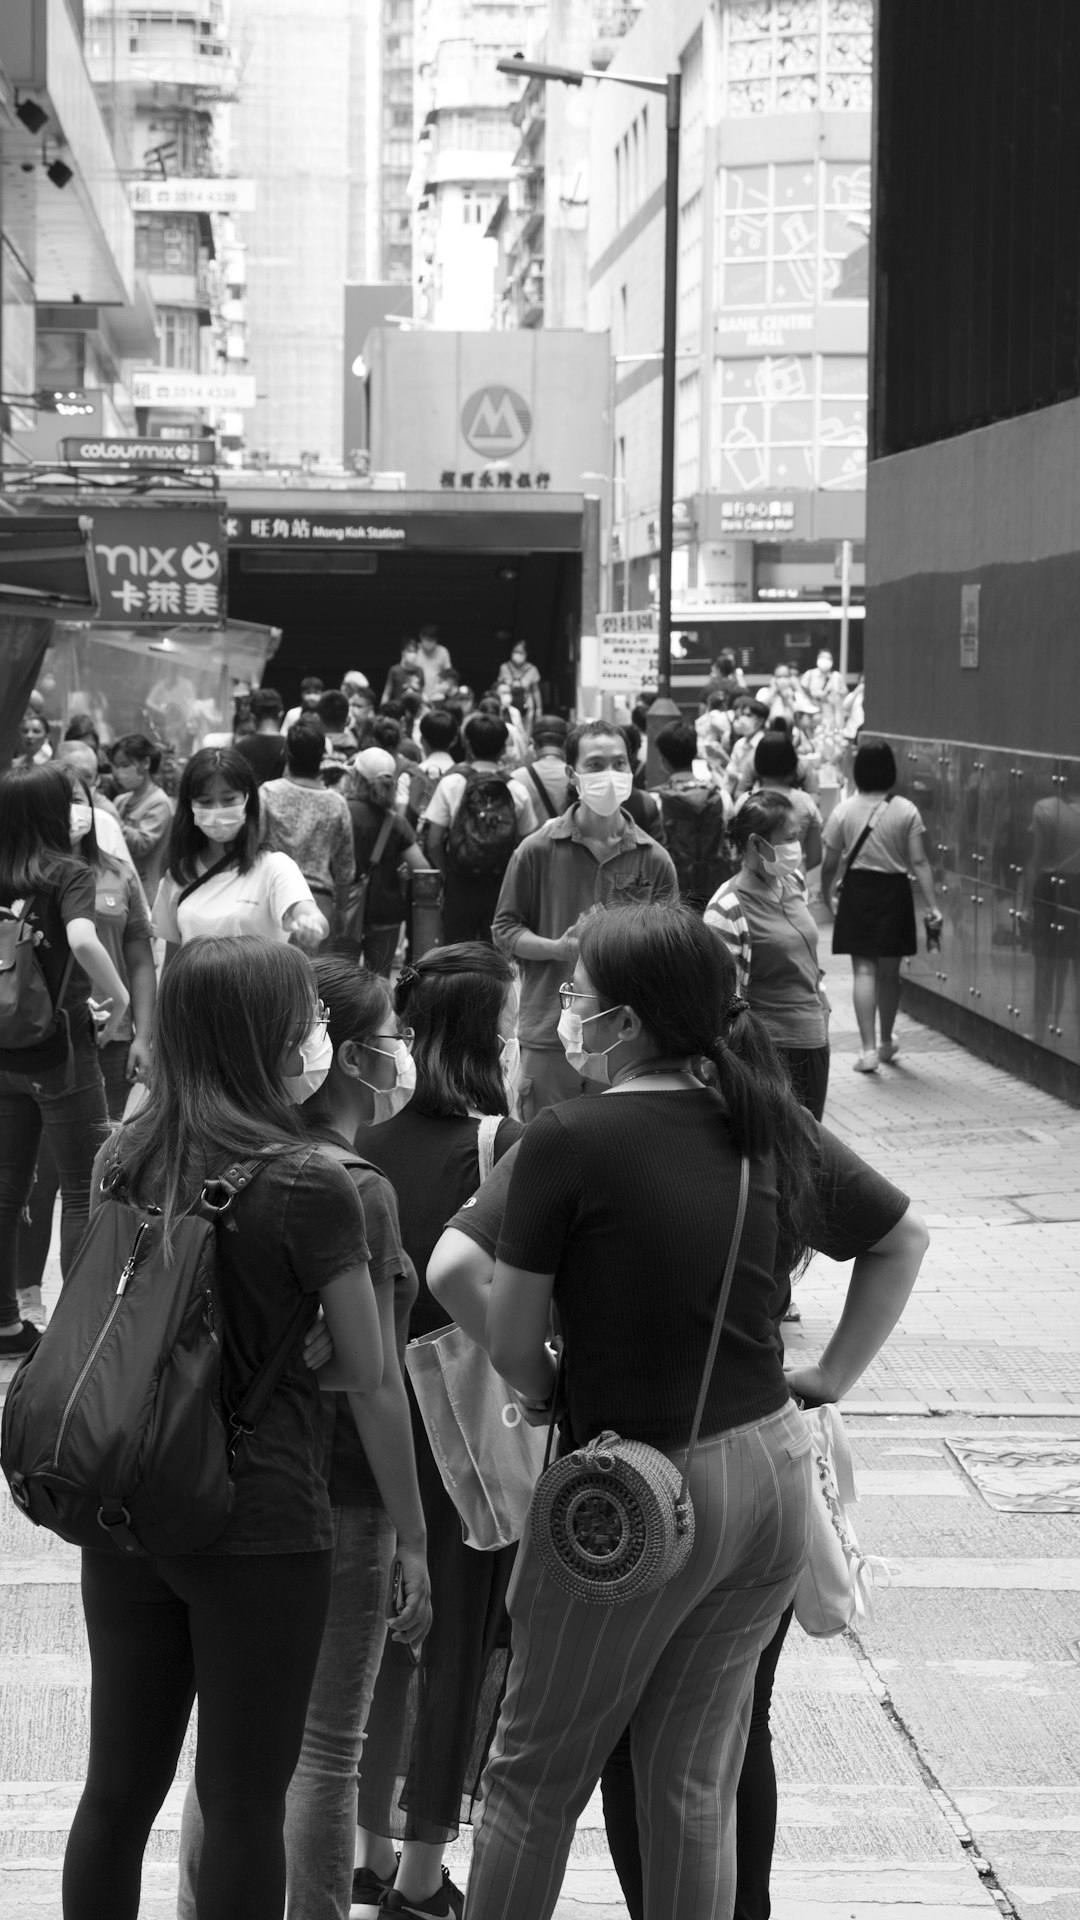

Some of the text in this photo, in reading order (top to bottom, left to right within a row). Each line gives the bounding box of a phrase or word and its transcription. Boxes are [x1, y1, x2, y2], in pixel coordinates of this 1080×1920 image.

[718, 312, 814, 334] BANK CENTRE
[746, 330, 785, 347] MALL
[251, 518, 406, 541] 旺角站 Mong Kok Station
[721, 519, 743, 533] Bank
[110, 579, 219, 616] 卡萊美
